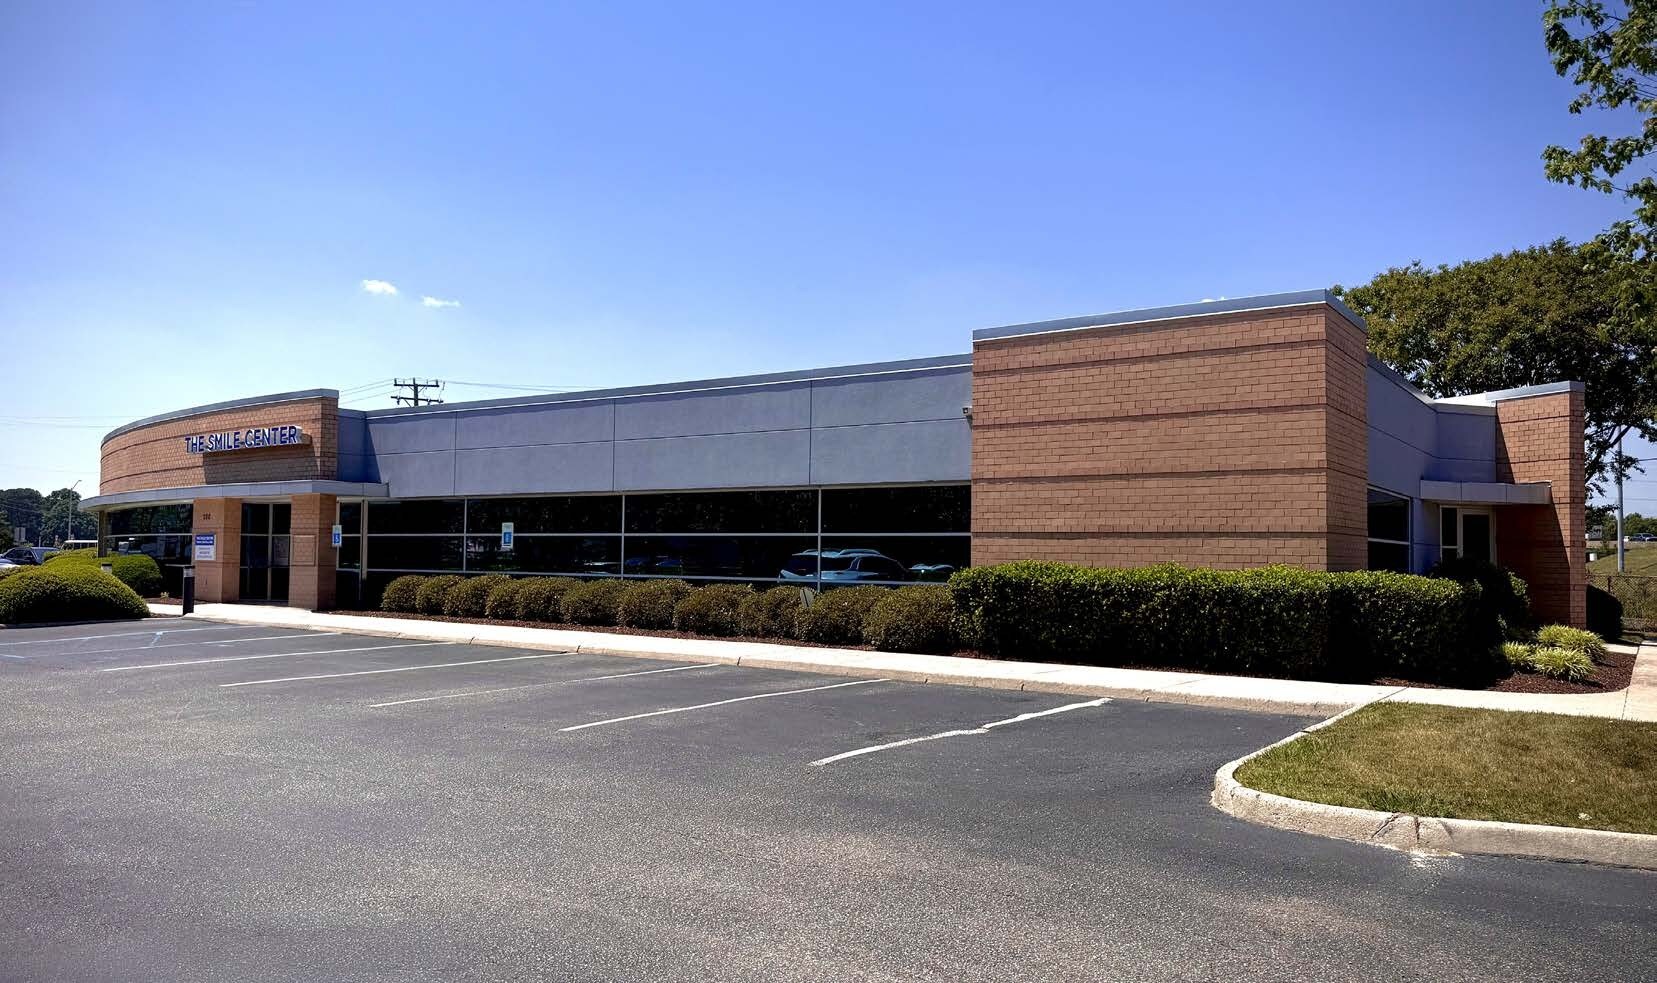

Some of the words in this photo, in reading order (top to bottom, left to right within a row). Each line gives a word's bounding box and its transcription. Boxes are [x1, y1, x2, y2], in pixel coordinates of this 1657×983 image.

[185, 435, 205, 453] THE
[208, 431, 241, 451] SMILE
[244, 425, 297, 448] CENTER
